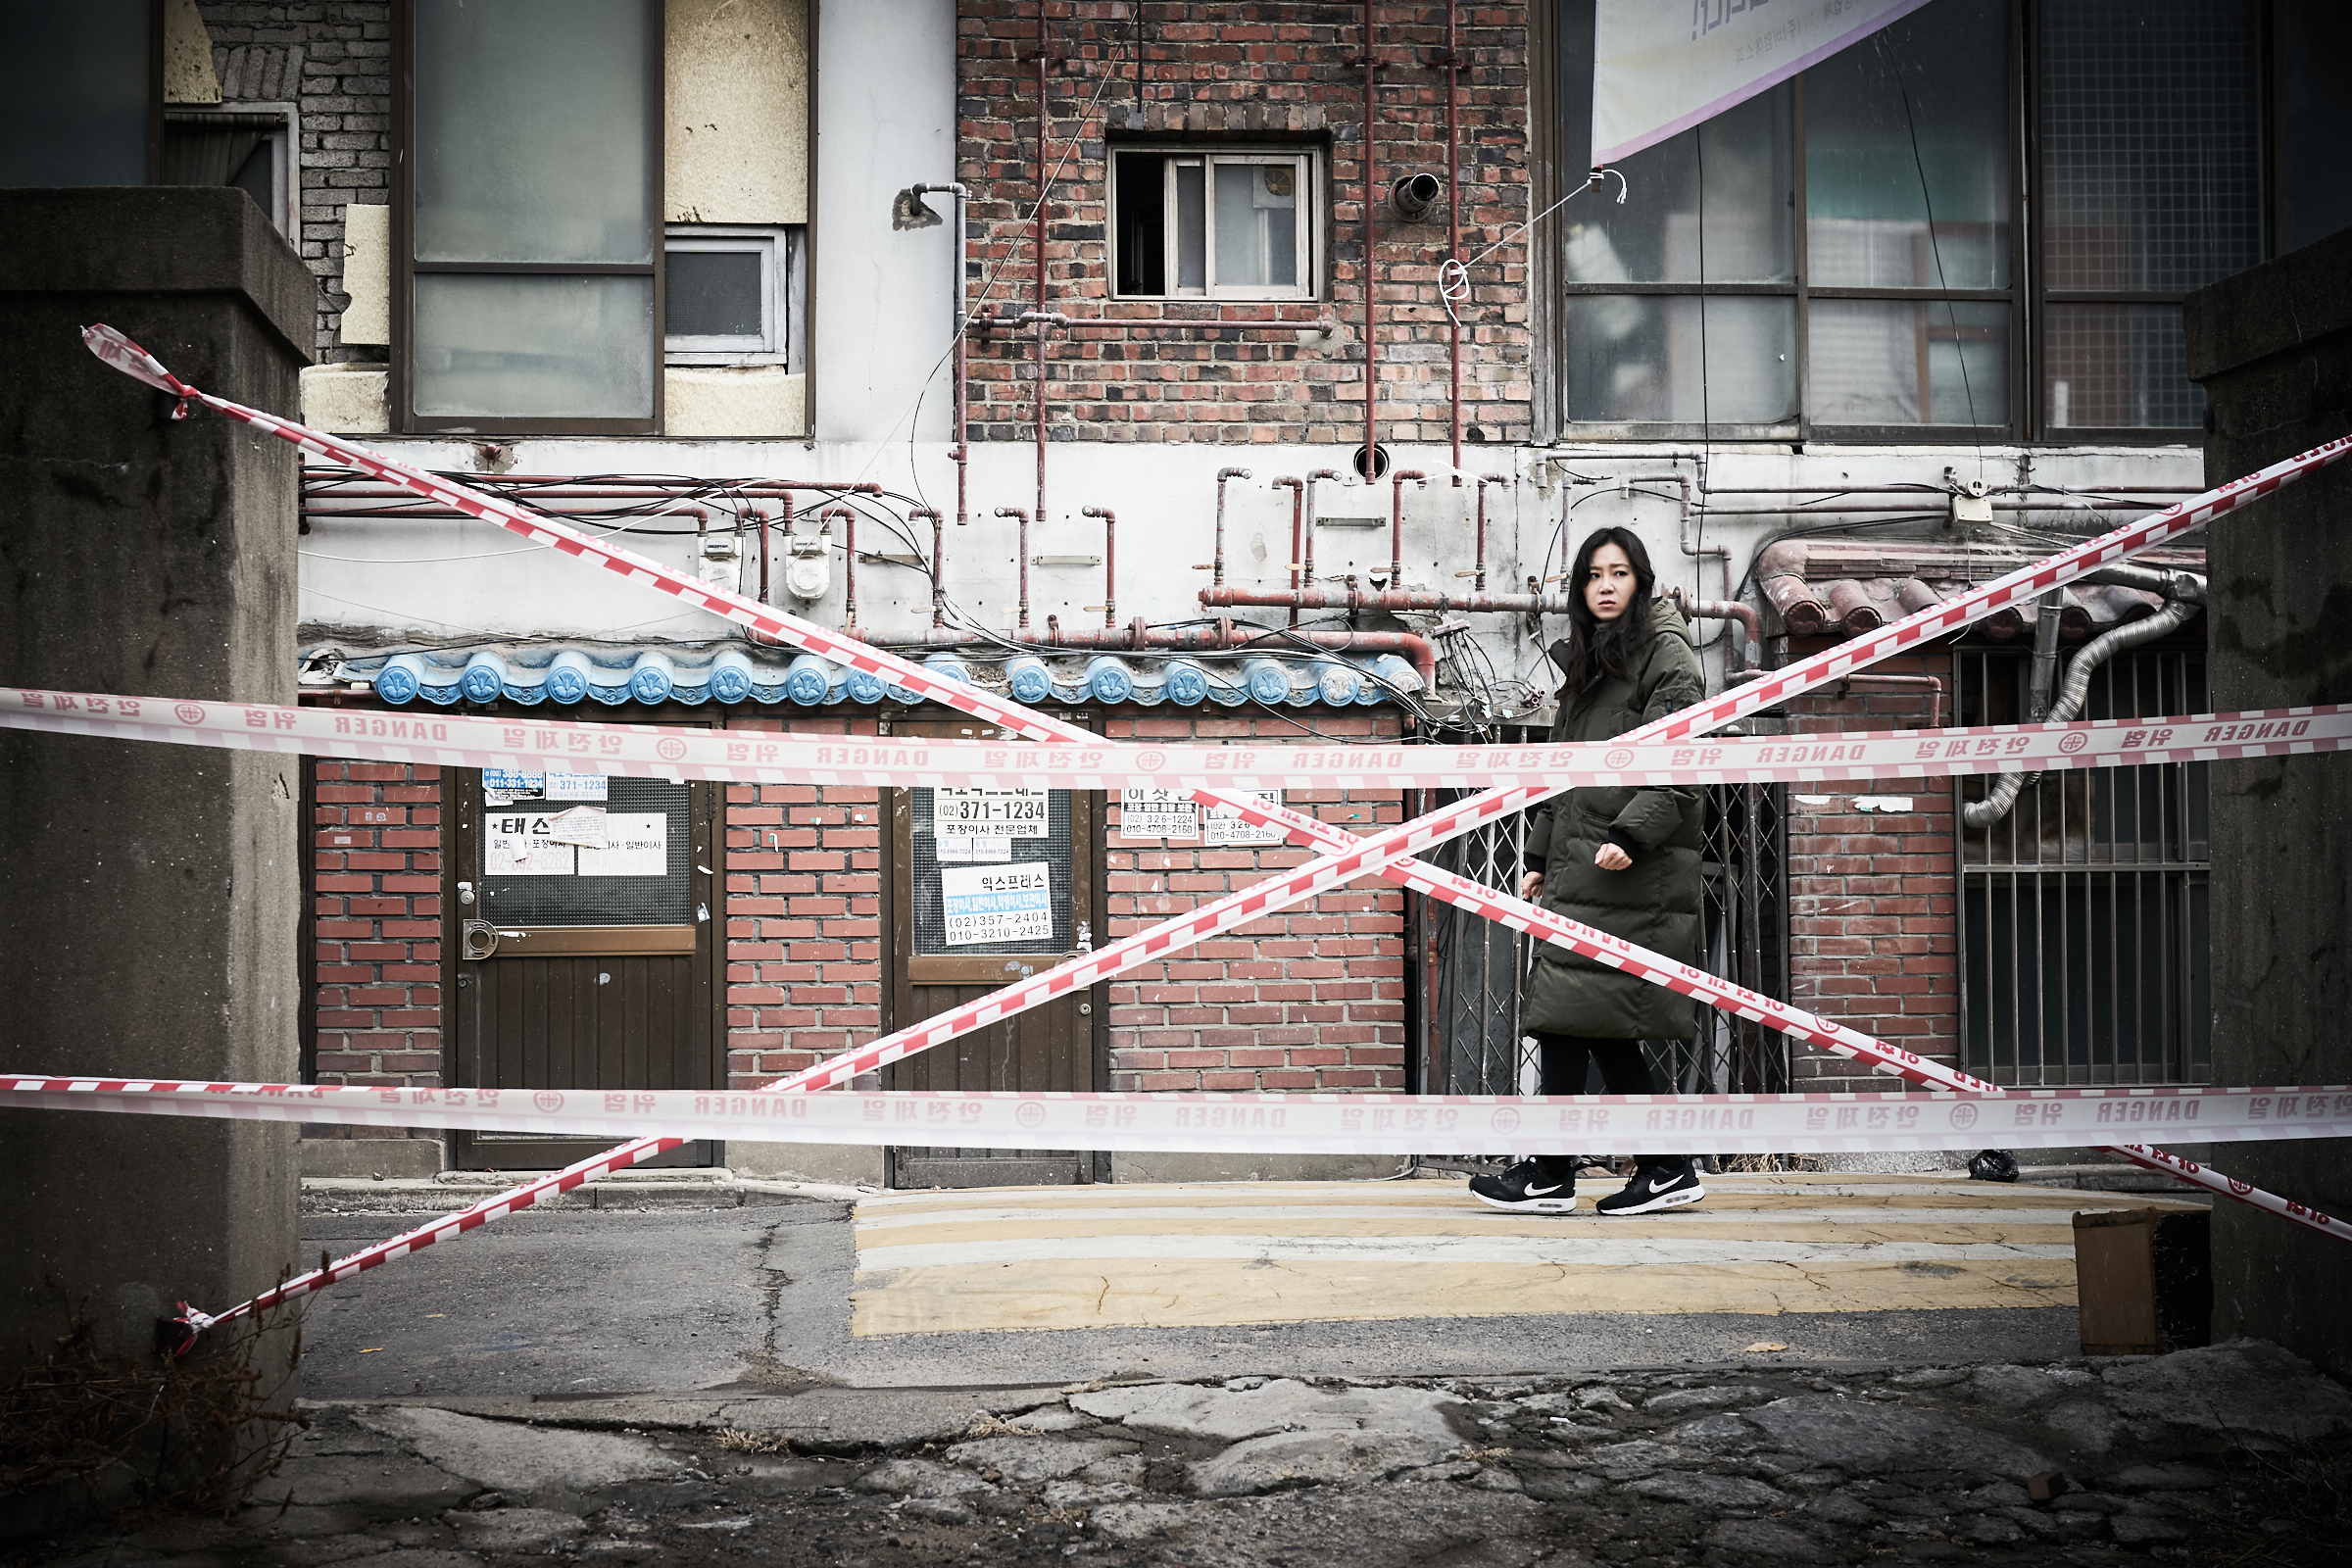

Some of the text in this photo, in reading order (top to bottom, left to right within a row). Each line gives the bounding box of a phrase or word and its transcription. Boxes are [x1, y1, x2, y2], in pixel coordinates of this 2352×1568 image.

[1127, 814, 1142, 823] (02)
[946, 824, 1038, 835] 포장이사 전문업체
[1126, 824, 1193, 834] 010-4708-2160
[982, 873, 1045, 892] 익스프레스
[949, 911, 1047, 929] (02)357-2404
[950, 925, 1050, 942] 010-3210-2425
